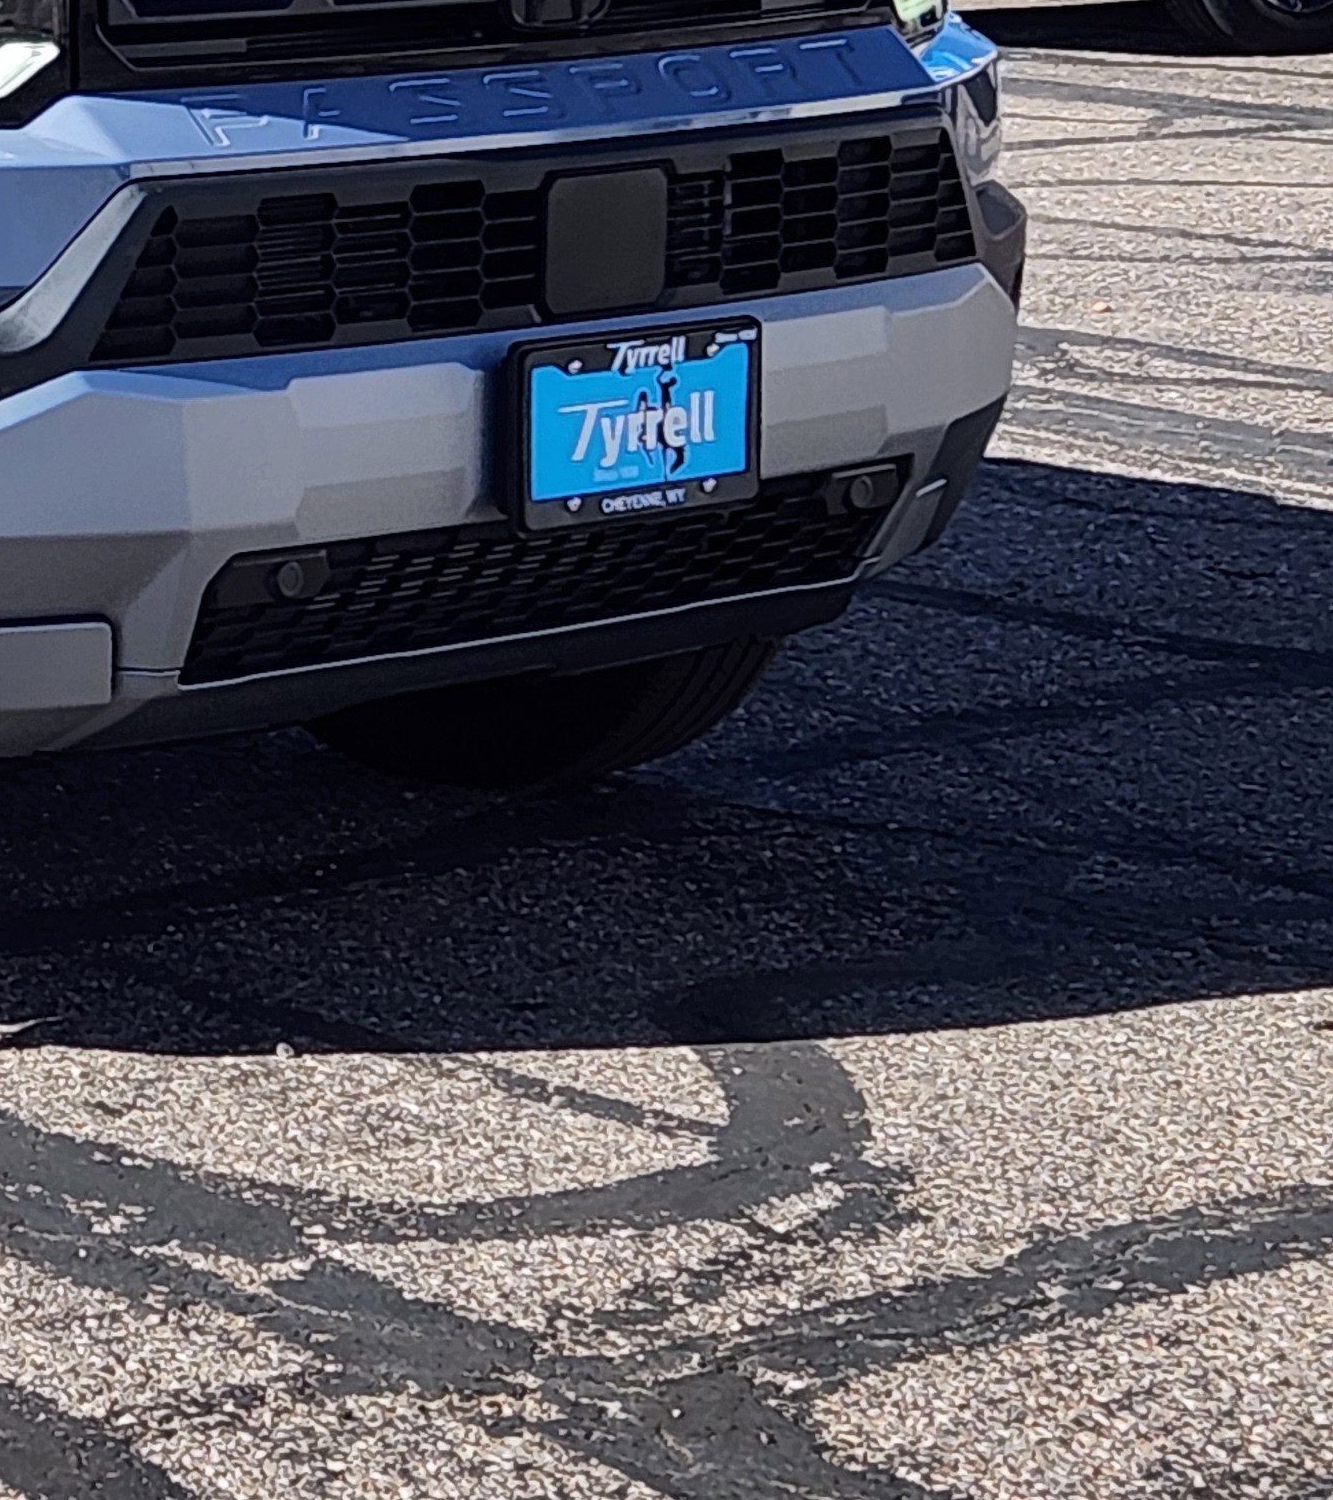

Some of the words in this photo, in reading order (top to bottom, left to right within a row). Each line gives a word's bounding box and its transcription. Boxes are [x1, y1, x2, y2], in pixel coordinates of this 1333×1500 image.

[180, 37, 858, 147] PASSPORT
[607, 336, 687, 373] Tyrrell
[558, 390, 715, 468] Tyrrell
